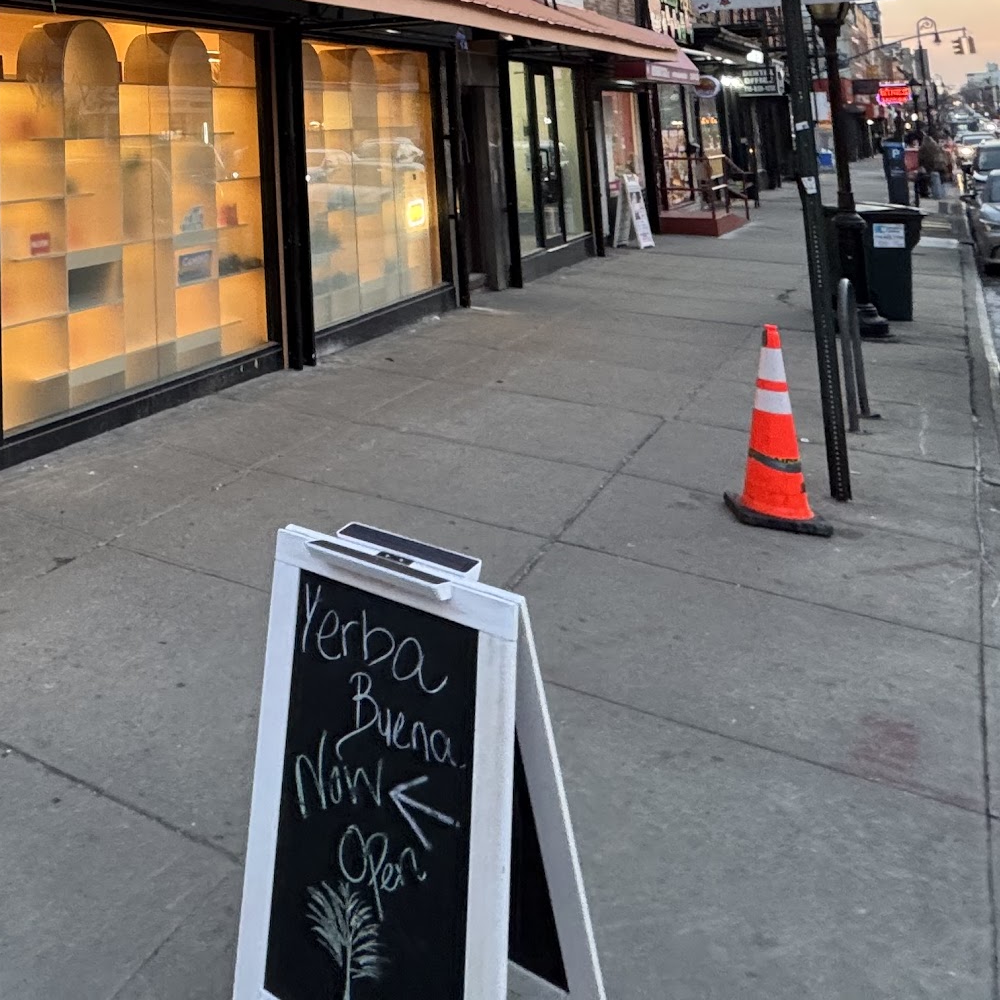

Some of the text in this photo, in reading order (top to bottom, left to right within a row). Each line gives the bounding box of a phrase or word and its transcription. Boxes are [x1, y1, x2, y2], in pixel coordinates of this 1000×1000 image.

[301, 583, 448, 694] Yerba
[295, 730, 383, 819] Now
[338, 824, 427, 921] Open
